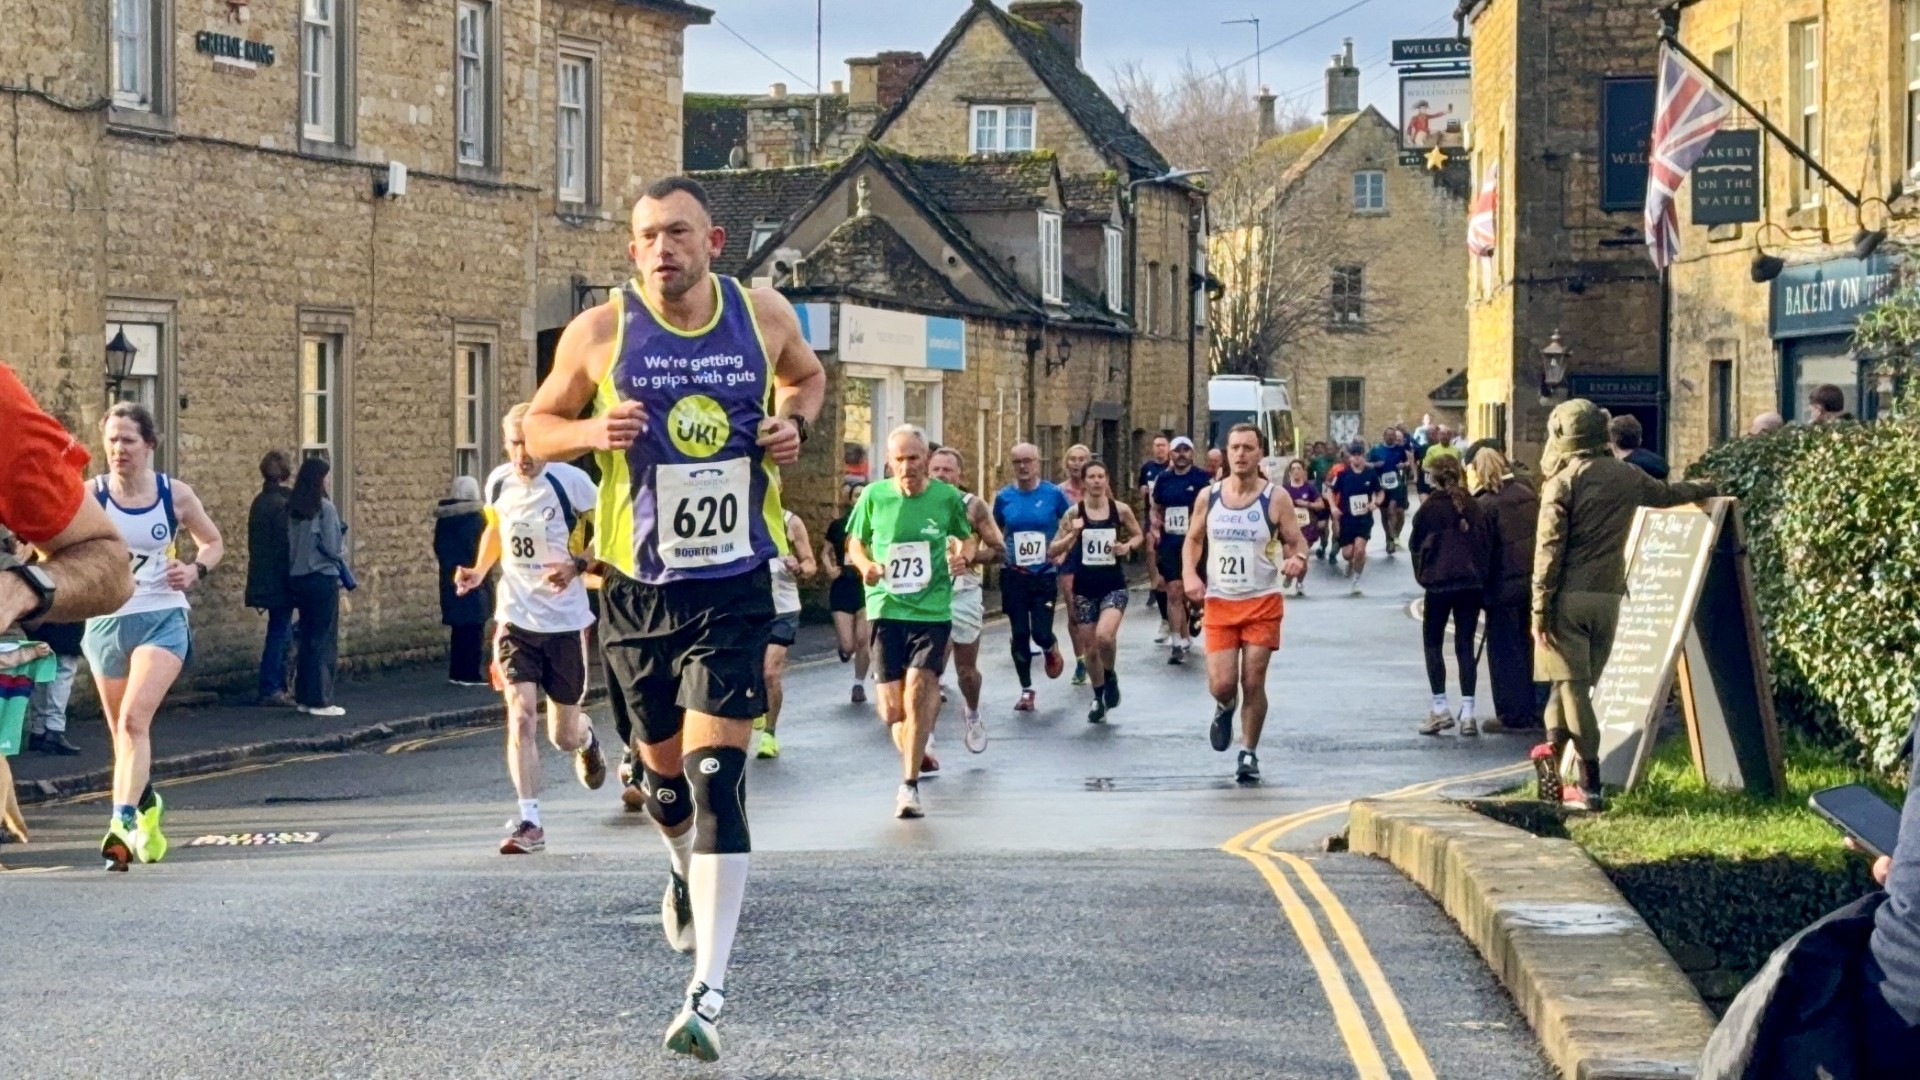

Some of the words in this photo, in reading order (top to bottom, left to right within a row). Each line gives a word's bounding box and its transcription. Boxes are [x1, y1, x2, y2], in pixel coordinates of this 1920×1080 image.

[196, 30, 241, 59] GREENE
[244, 40, 275, 67] KING
[1402, 44, 1441, 54] WELLS
[1444, 43, 1452, 52] &
[1698, 179, 1717, 189] ON
[1726, 178, 1752, 188] THE
[1699, 197, 1752, 206] WATER
[1785, 279, 1836, 316] BAKERY
[1840, 276, 1861, 309] ON
[644, 355, 688, 369] We're
[691, 353, 743, 371] getting
[632, 375, 647, 387] to
[651, 371, 688, 389] grips
[692, 369, 722, 384] with
[727, 369, 756, 386] guts
[673, 493, 738, 539] 620
[1215, 514, 1244, 524] JOEL
[1649, 513, 1665, 531] The
[1212, 528, 1259, 537] WITNEY
[511, 536, 535, 558] 38
[674, 545, 718, 557] BOURTON
[1019, 541, 1041, 555] 607
[1087, 540, 1112, 554] 616
[890, 557, 924, 579] 273
[1219, 556, 1245, 575] 221
